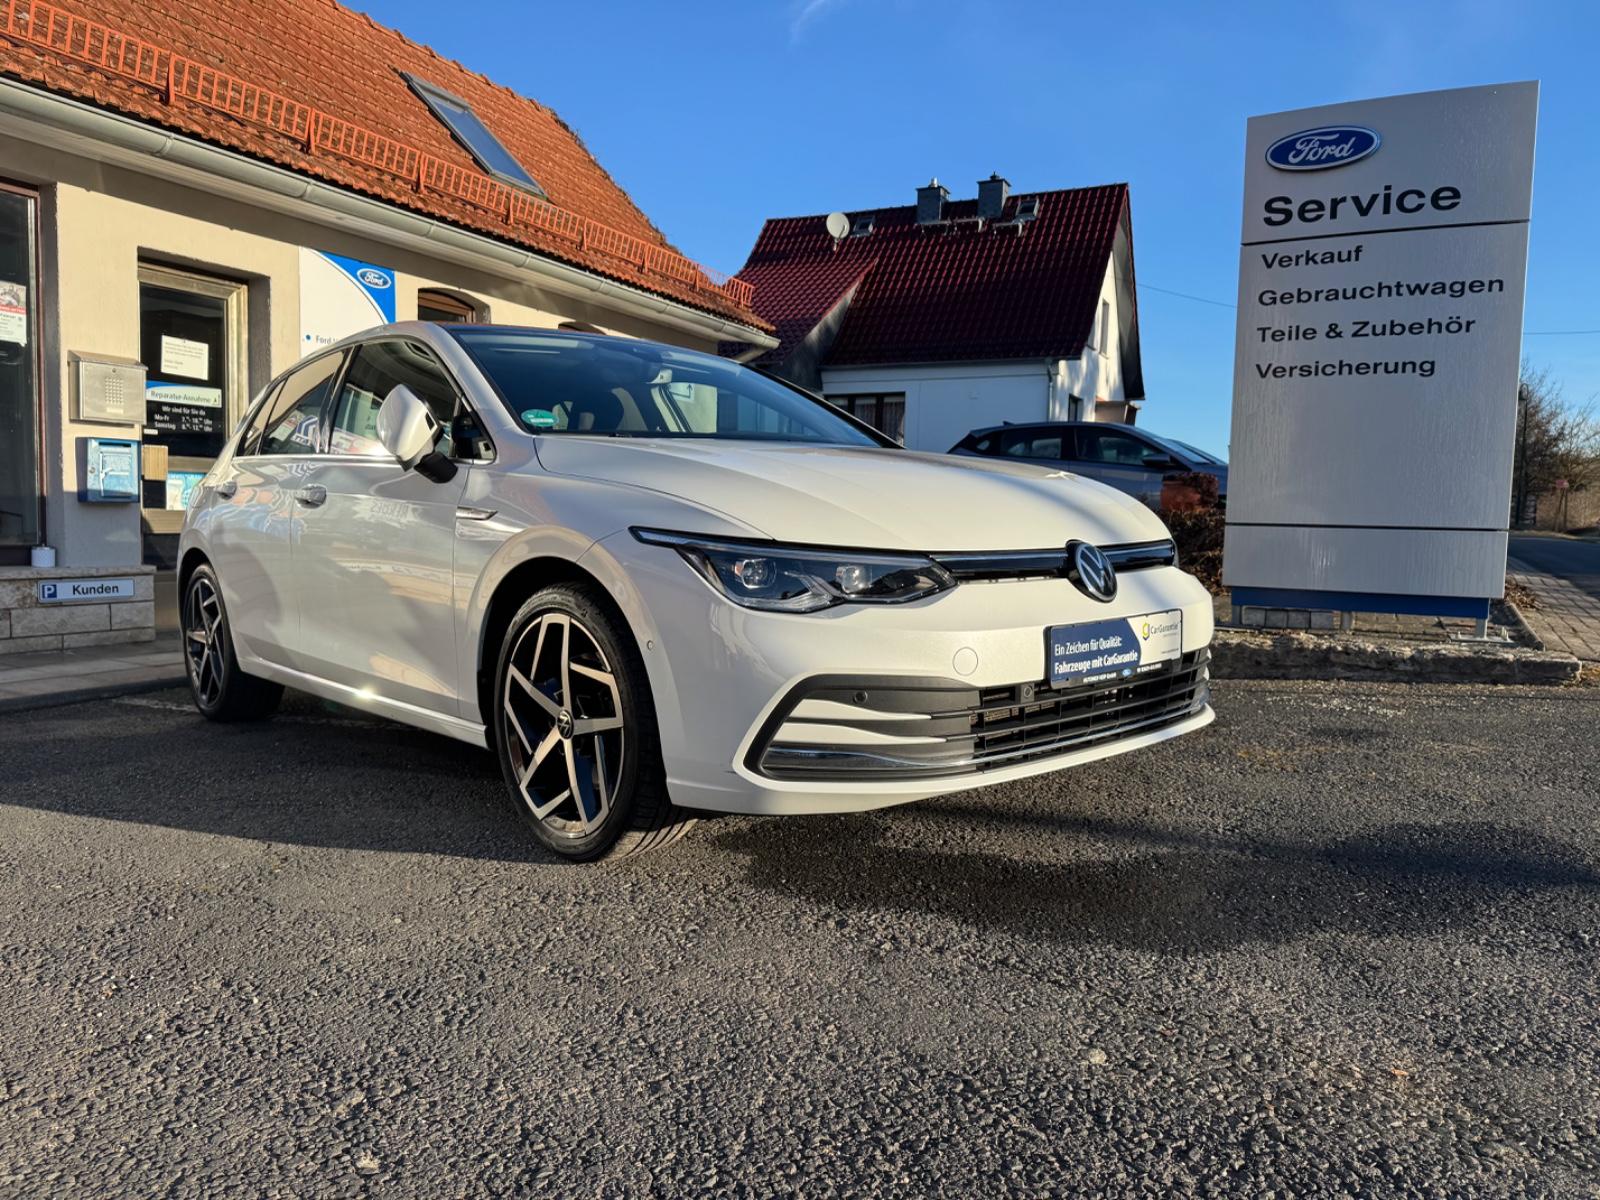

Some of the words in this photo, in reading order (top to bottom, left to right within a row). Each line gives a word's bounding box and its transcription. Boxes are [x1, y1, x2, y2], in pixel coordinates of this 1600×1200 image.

[1287, 133, 1354, 164] Ford
[1262, 184, 1462, 227] Service
[1261, 245, 1363, 269] Verkauf
[1258, 278, 1505, 306] Gebrauchtwagen
[1257, 325, 1318, 343] Teile
[1325, 322, 1344, 339] &
[1352, 316, 1476, 338] Zubehör
[1255, 359, 1436, 379] Versicherung
[44, 585, 55, 598] P
[72, 584, 119, 595] Kunden
[1055, 644, 1065, 656] Ein
[1066, 641, 1089, 654] Zeichen
[1090, 639, 1099, 650] für
[1055, 660, 1091, 674] Fahrzeuge
[1092, 656, 1103, 668] mit
[1104, 650, 1138, 666] CarGarantie
